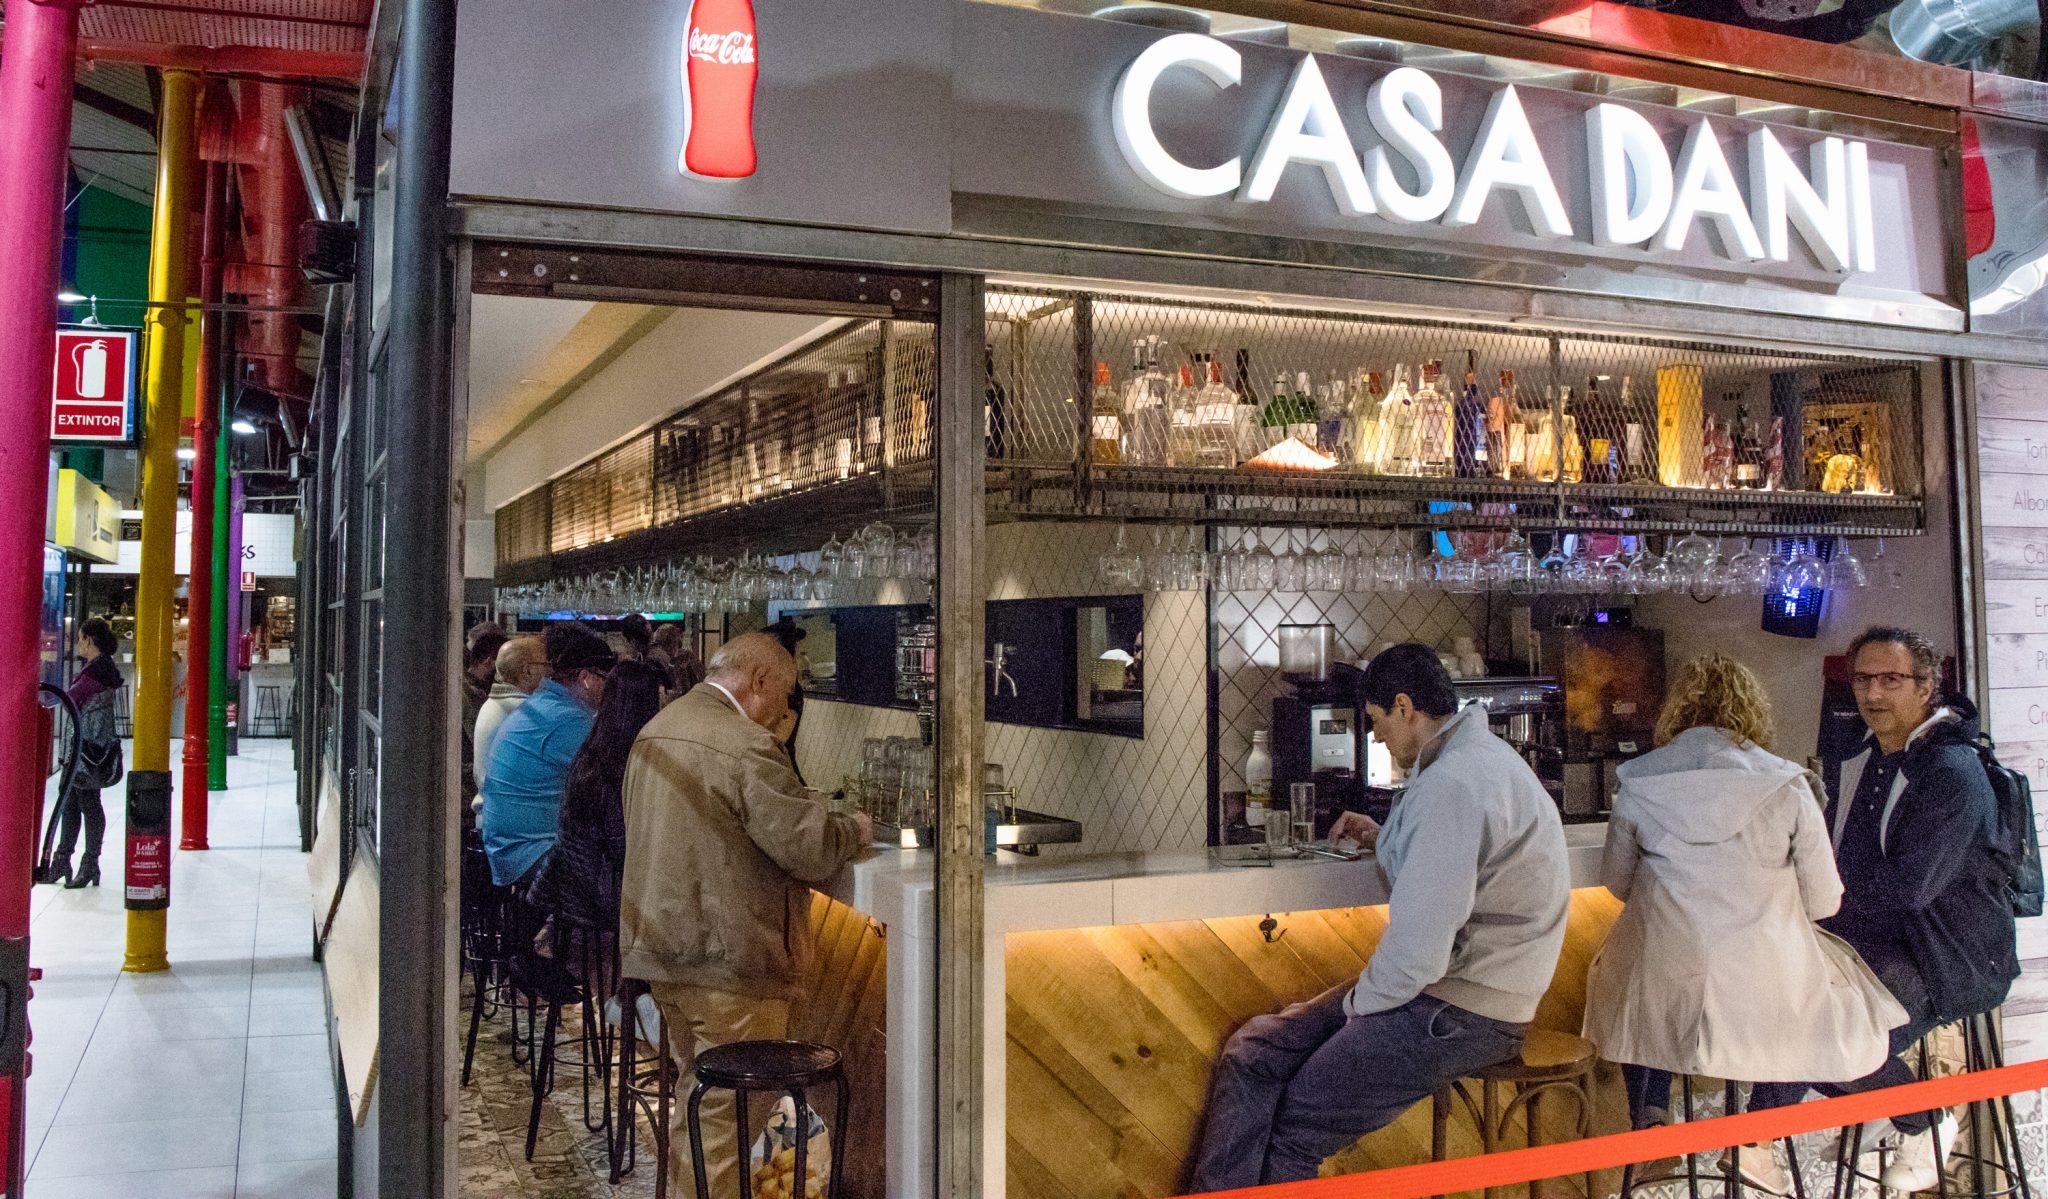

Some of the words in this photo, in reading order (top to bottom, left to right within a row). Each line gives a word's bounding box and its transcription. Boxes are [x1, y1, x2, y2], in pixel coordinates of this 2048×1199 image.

[689, 27, 755, 64] Coca-Cola
[1112, 33, 1573, 236] CASA
[1586, 102, 1876, 273] DANI
[58, 414, 120, 426] EXTINTOR
[136, 842, 156, 850] Lola
